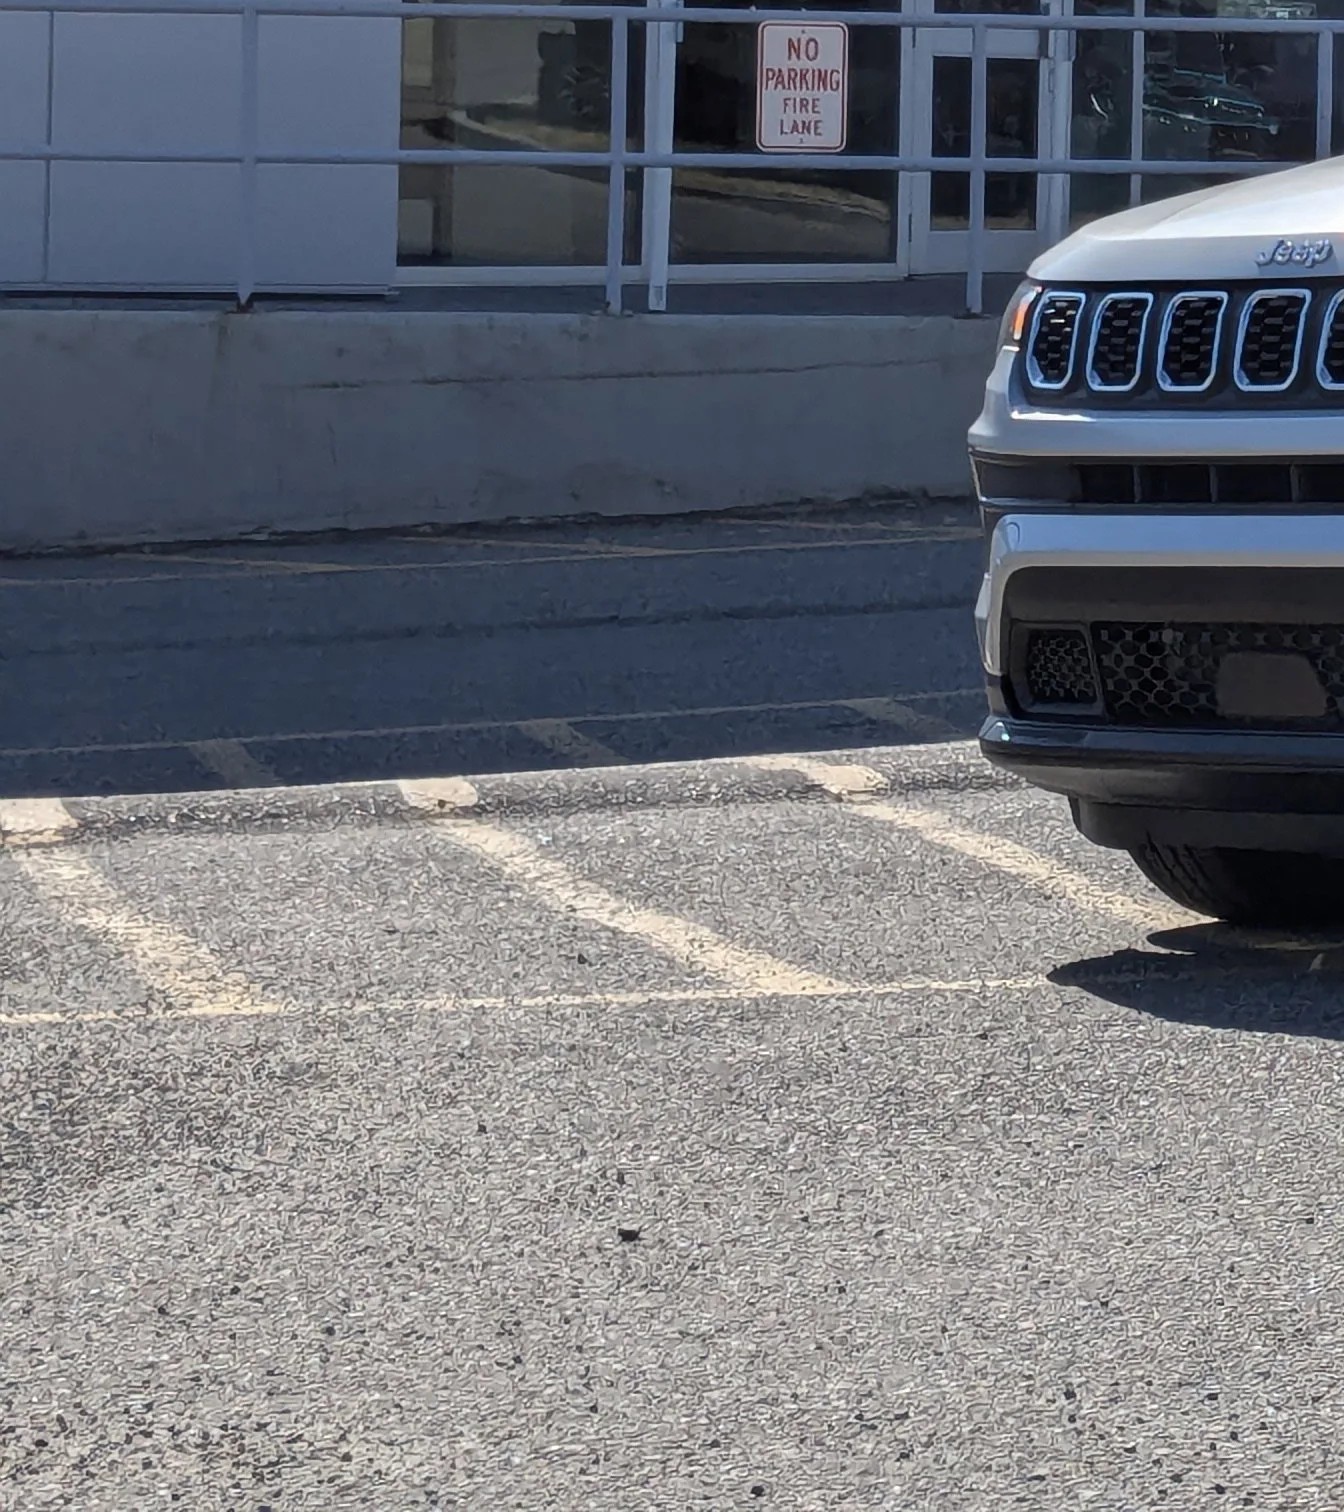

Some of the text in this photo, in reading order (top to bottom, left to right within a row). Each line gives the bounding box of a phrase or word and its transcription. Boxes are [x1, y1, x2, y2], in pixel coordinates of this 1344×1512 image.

[787, 37, 819, 62] NO
[764, 67, 841, 92] PARKING
[782, 97, 822, 115] FIRE
[779, 119, 823, 137] LANE
[1255, 239, 1334, 269] Jeep
